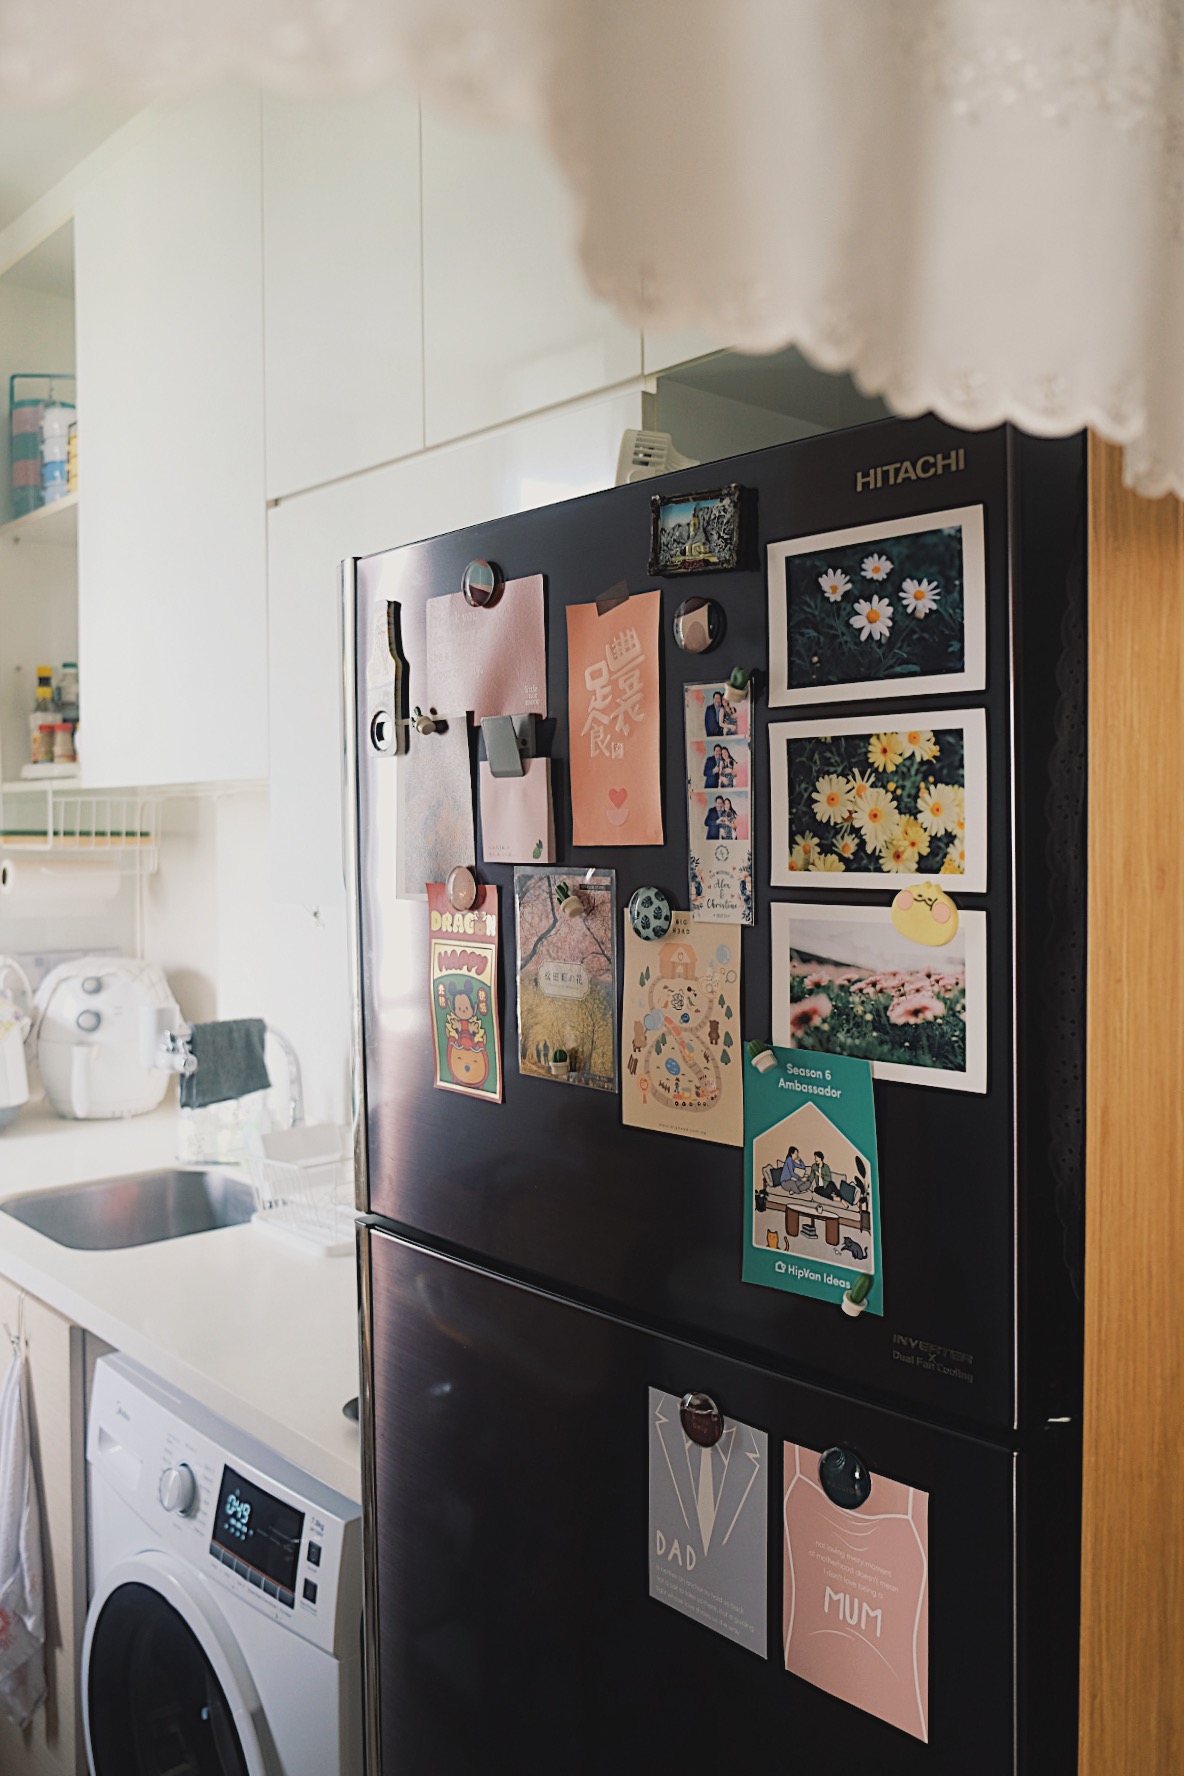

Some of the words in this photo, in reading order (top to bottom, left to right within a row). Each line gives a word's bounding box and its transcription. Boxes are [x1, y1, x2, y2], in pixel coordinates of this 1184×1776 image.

[856, 448, 965, 492] HITACHI
[706, 898, 738, 910] Christine
[778, 1078, 841, 1098] Ambassador
[787, 1063, 822, 1079] Season
[825, 1070, 831, 1080] 6
[788, 1264, 821, 1282] HipVan
[824, 1273, 850, 1289] Ideas
[892, 1333, 974, 1365] INVERTER
[892, 1350, 914, 1365] Dual
[916, 1356, 935, 1370] Fan
[936, 1362, 974, 1384] Cooling
[656, 1529, 697, 1571] DAD
[816, 1540, 826, 1549] not
[827, 1544, 845, 1559] loving
[847, 1554, 864, 1567] every
[865, 1561, 892, 1578] moment
[808, 1549, 815, 1558] of
[816, 1553, 854, 1574] motherhood
[880, 1580, 899, 1593] mean
[844, 1576, 857, 1588] love
[858, 1583, 876, 1598] being
[824, 1585, 882, 1638] MUM
